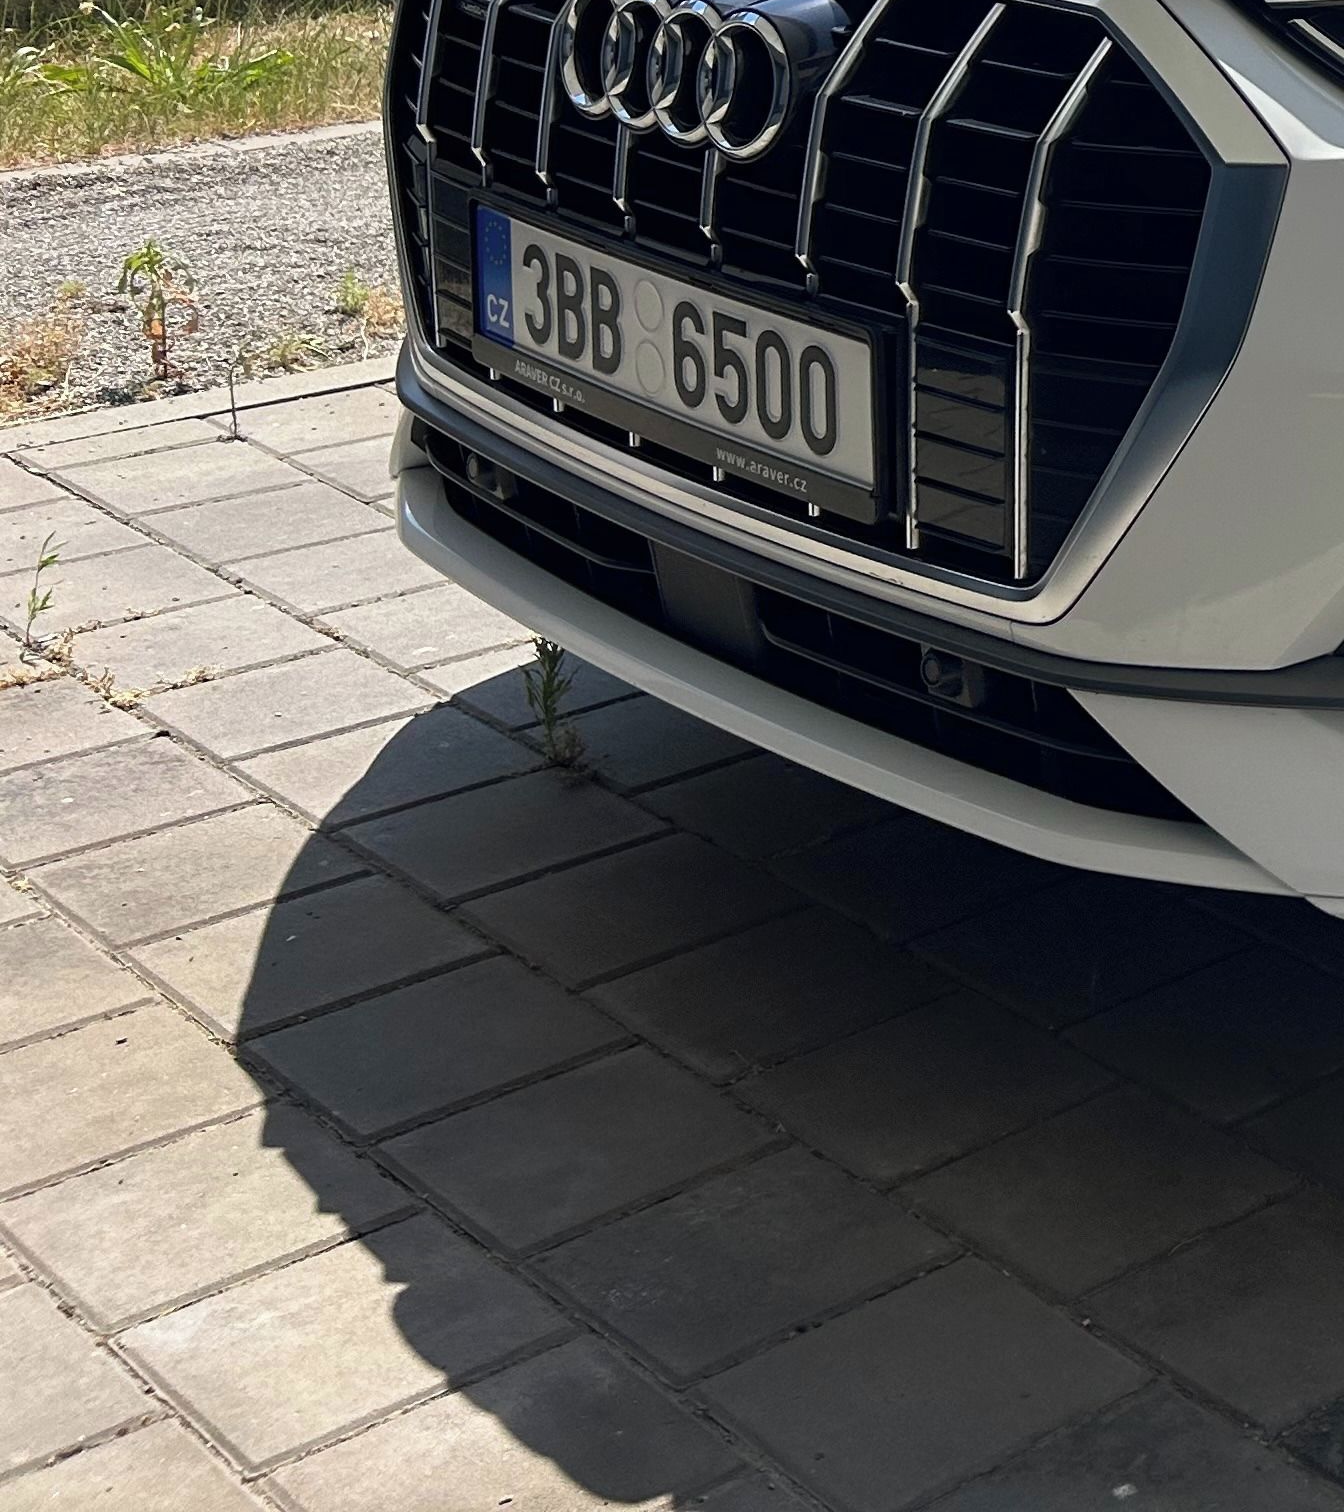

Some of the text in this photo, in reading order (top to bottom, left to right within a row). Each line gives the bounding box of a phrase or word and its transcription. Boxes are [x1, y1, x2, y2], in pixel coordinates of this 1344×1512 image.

[486, 293, 511, 328] CZ
[522, 243, 837, 456] 3BB 6500
[515, 359, 586, 404] ARAVER CZ s.r.o.
[716, 447, 808, 493] www.araver.cz
